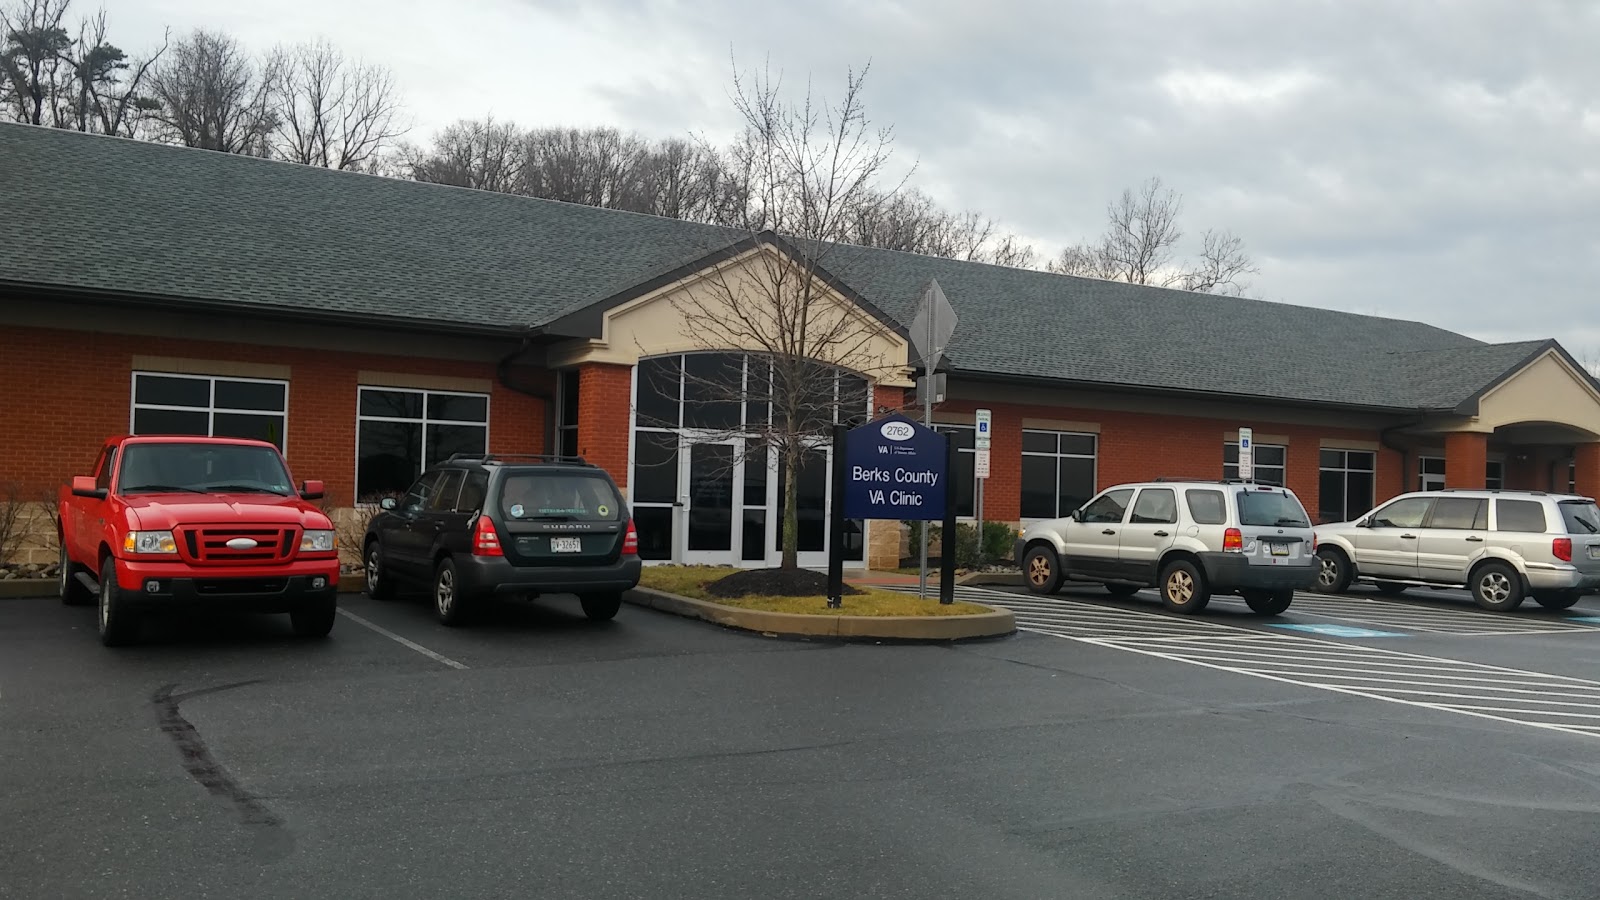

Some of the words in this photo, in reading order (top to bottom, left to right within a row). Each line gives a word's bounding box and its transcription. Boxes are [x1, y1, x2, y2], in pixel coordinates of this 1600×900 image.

[886, 426, 909, 437] 2762
[877, 445, 889, 454] VA
[852, 466, 890, 482] Berks
[894, 467, 939, 487] County
[868, 489, 886, 505] VA
[889, 489, 923, 506] Clinic
